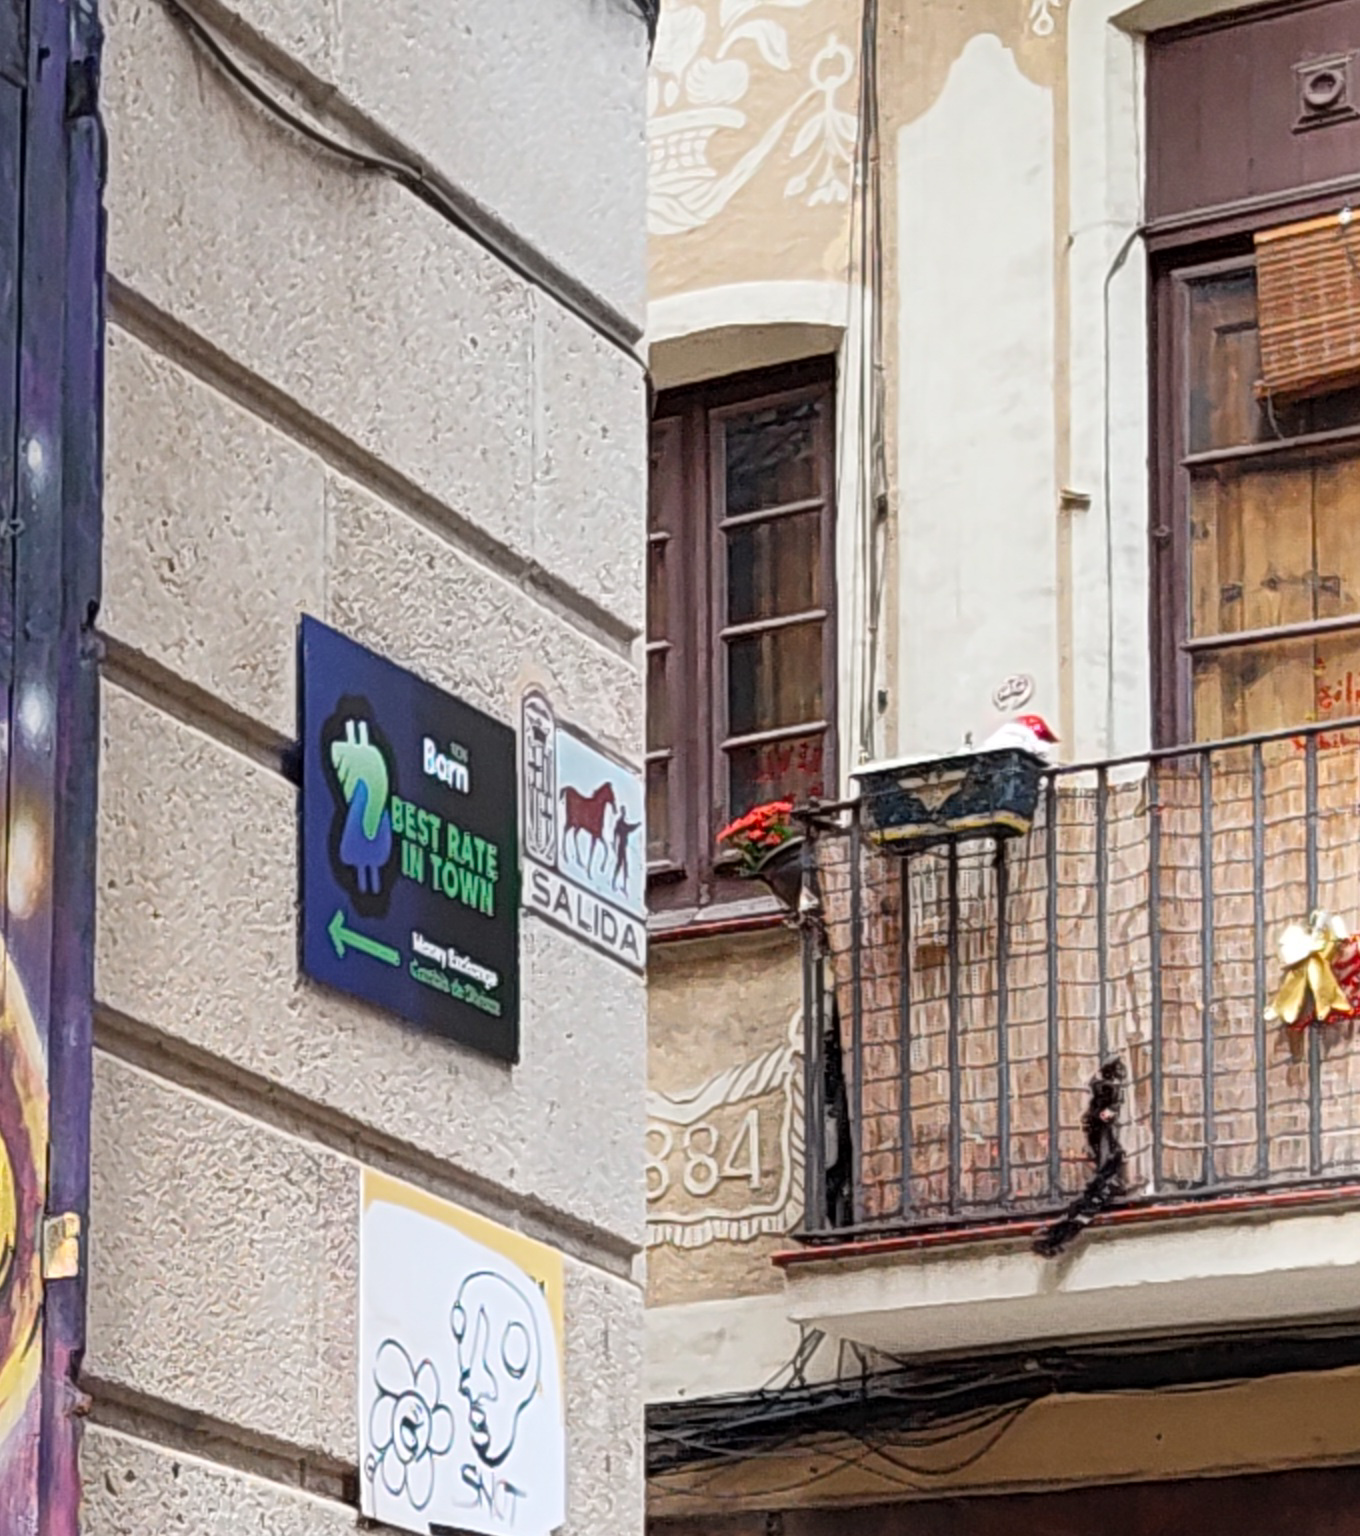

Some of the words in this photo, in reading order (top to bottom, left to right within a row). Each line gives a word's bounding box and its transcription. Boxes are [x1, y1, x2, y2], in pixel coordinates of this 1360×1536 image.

[423, 736, 469, 795] Born
[391, 795, 442, 853] BEST
[447, 822, 499, 881] RATE
[401, 838, 424, 884] IN
[430, 853, 495, 917] TOWN
[529, 871, 641, 963] SALIDA
